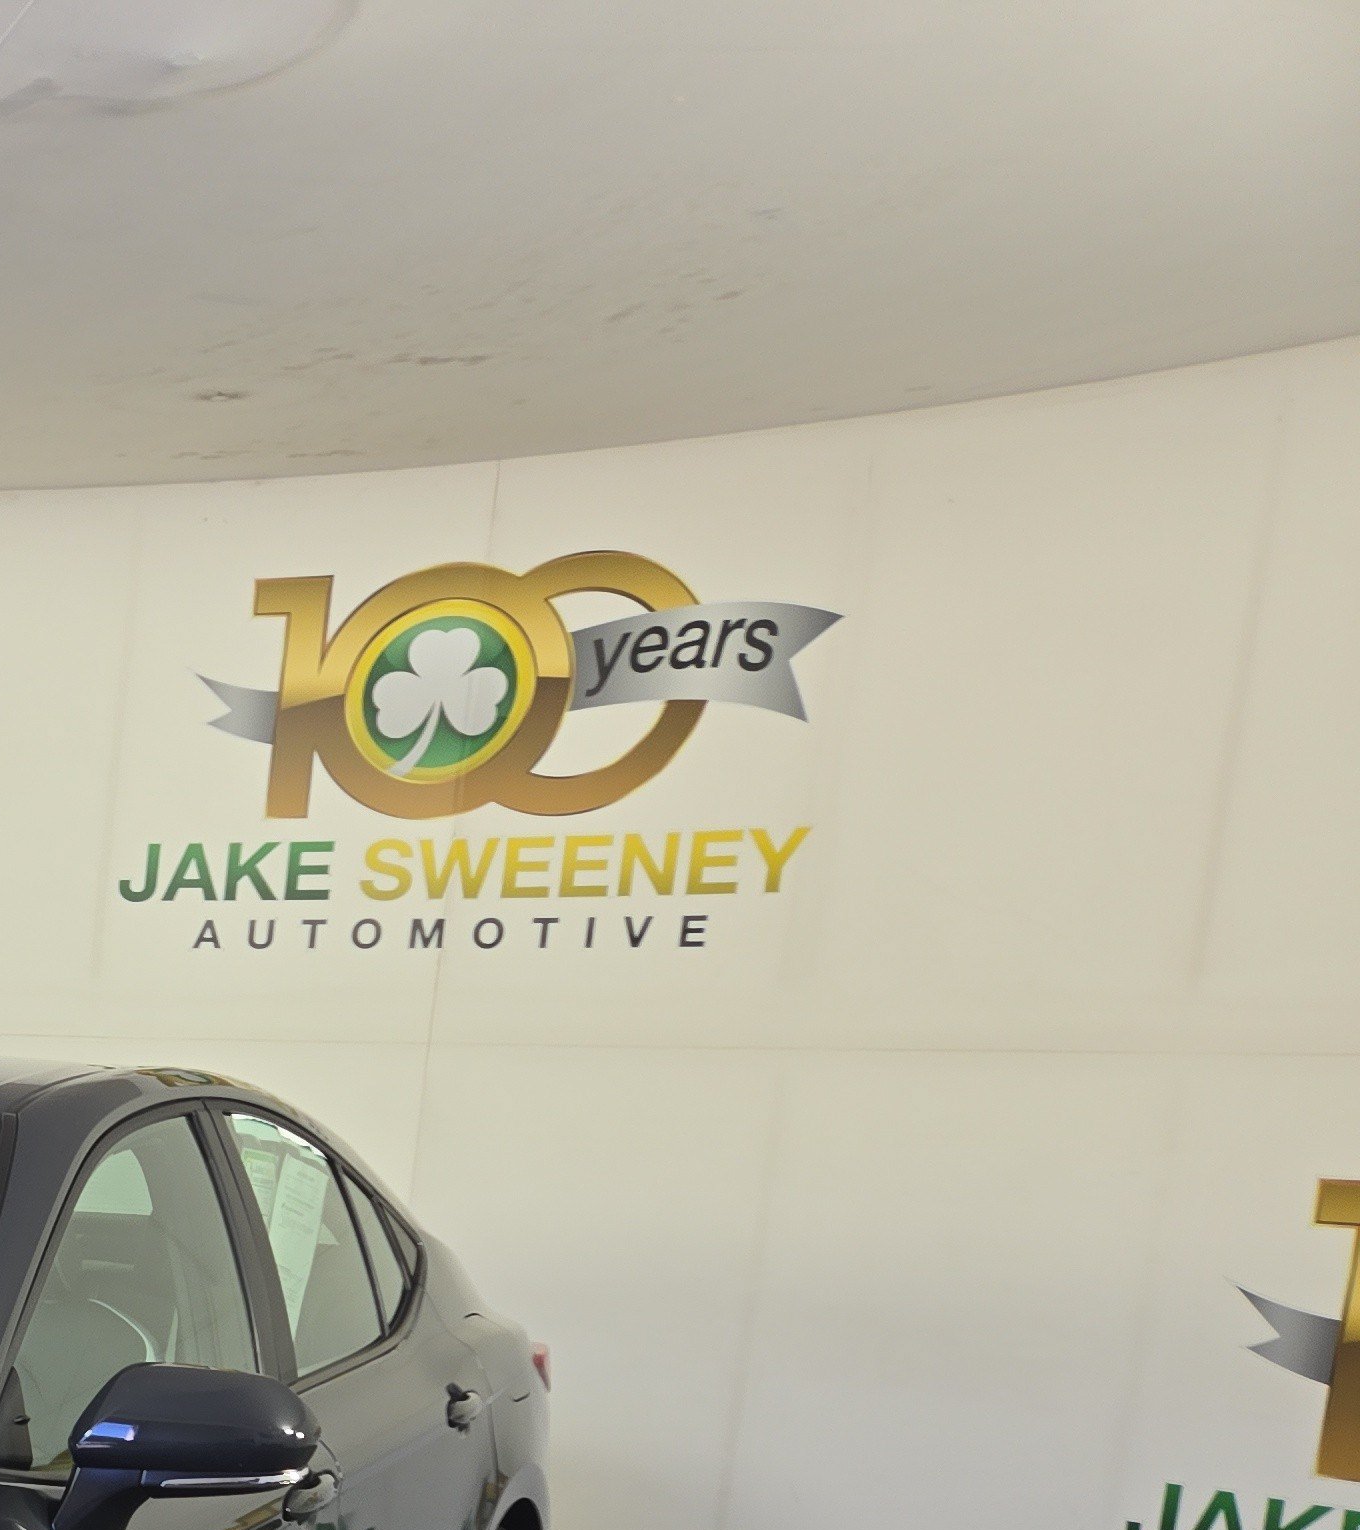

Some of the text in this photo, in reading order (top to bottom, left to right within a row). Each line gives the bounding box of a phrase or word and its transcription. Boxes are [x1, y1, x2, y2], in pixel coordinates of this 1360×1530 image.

[253, 549, 708, 819] 100
[585, 618, 779, 697] years
[118, 826, 812, 902] JAKE SWEENEY
[192, 914, 709, 950] AUTOMOTIVE
